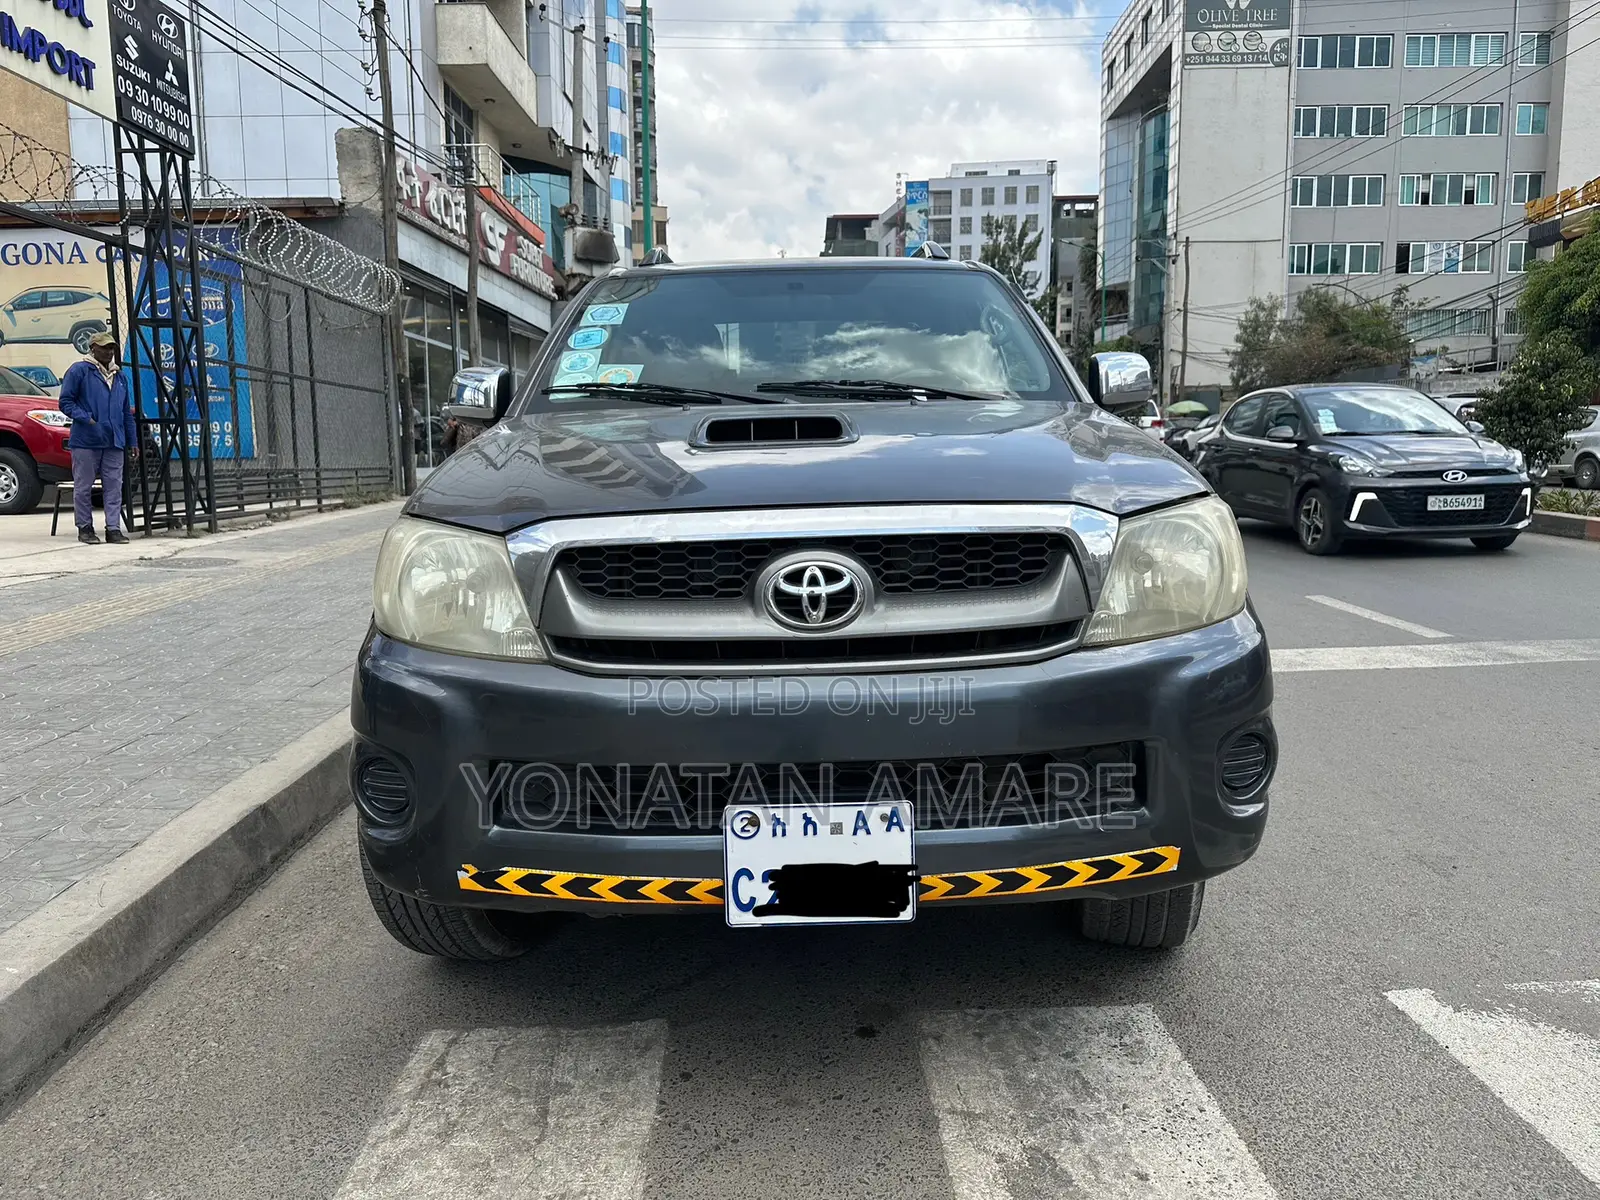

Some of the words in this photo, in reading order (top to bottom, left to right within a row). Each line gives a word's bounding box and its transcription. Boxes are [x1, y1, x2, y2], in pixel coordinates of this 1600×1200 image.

[112, 4, 143, 33] TOYOTA
[1197, 8, 1239, 23] OLIVE
[1245, 8, 1278, 21] TREE
[0, 11, 96, 91] IMPORT
[151, 29, 184, 60] HYUNDAI
[1186, 53, 1203, 64] +251
[1206, 53, 1219, 63] 944
[1221, 53, 1230, 62] 33
[1232, 53, 1241, 62] 69
[1244, 52, 1253, 62] 13
[1259, 52, 1268, 62] 14
[116, 53, 151, 84] SUZUKI
[156, 78, 187, 105] MITSUBISHI
[131, 106, 153, 129] 0976
[155, 118, 165, 136] 30
[167, 125, 177, 142] 00
[179, 132, 189, 148] 00
[1, 242, 89, 266] GONA
